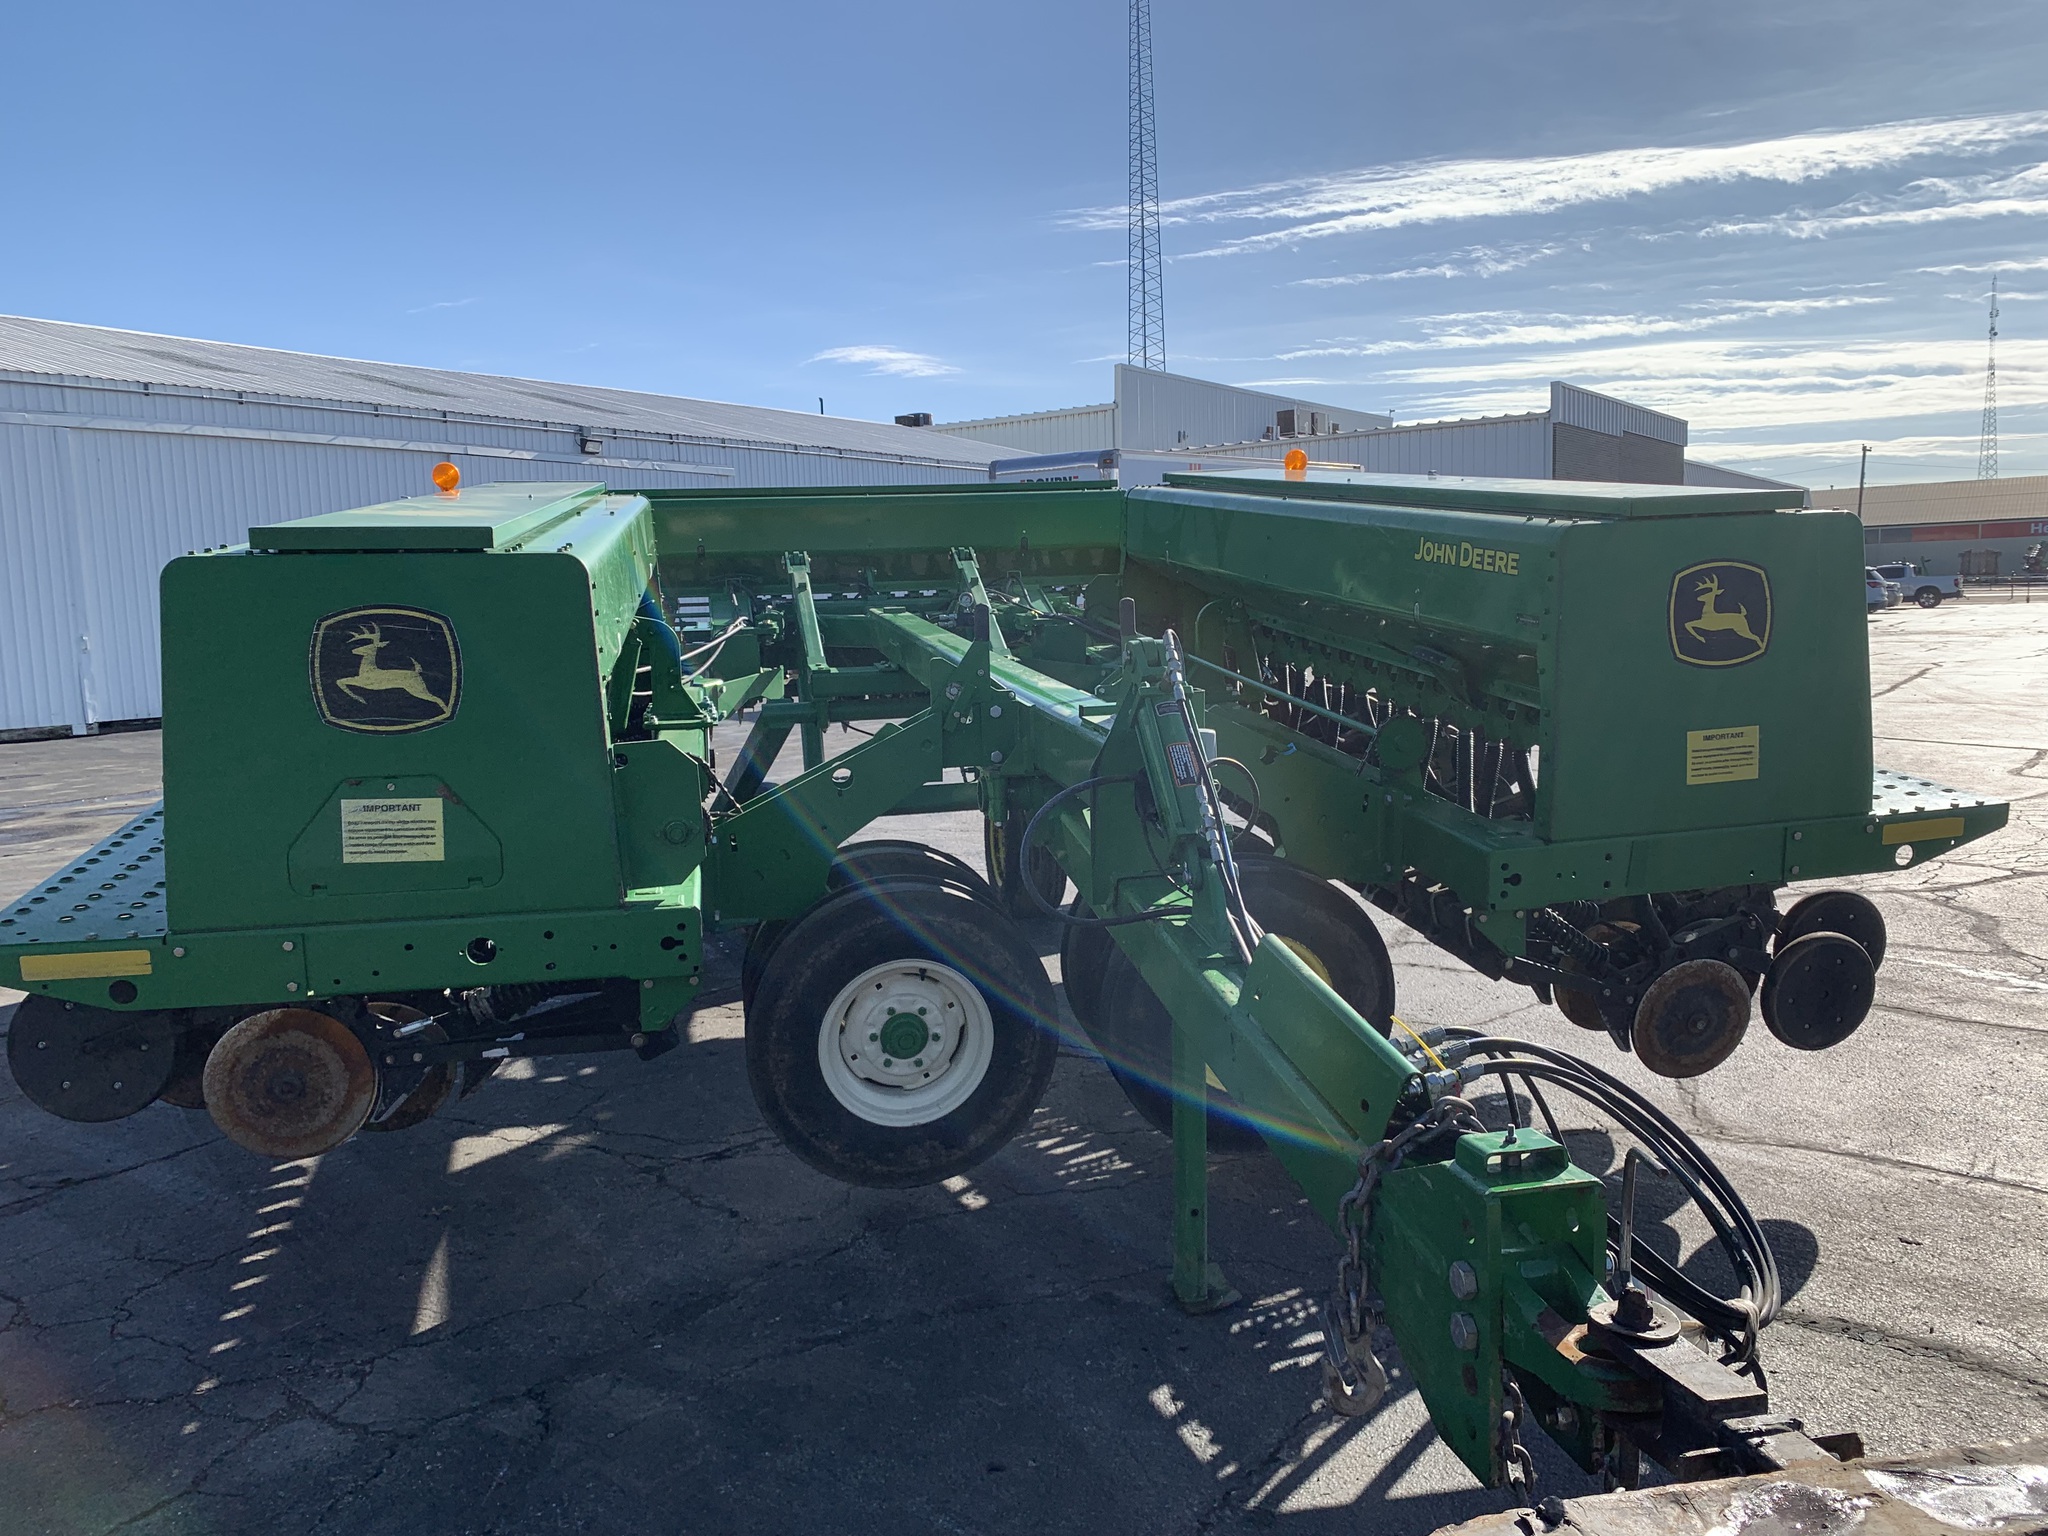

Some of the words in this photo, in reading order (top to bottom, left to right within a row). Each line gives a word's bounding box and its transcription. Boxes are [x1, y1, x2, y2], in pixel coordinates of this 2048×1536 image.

[1414, 536, 1457, 565] JOHN
[1459, 541, 1520, 575] DEERE
[1702, 731, 1744, 741] IMPORTANT
[362, 803, 421, 812] IMPORTANT
